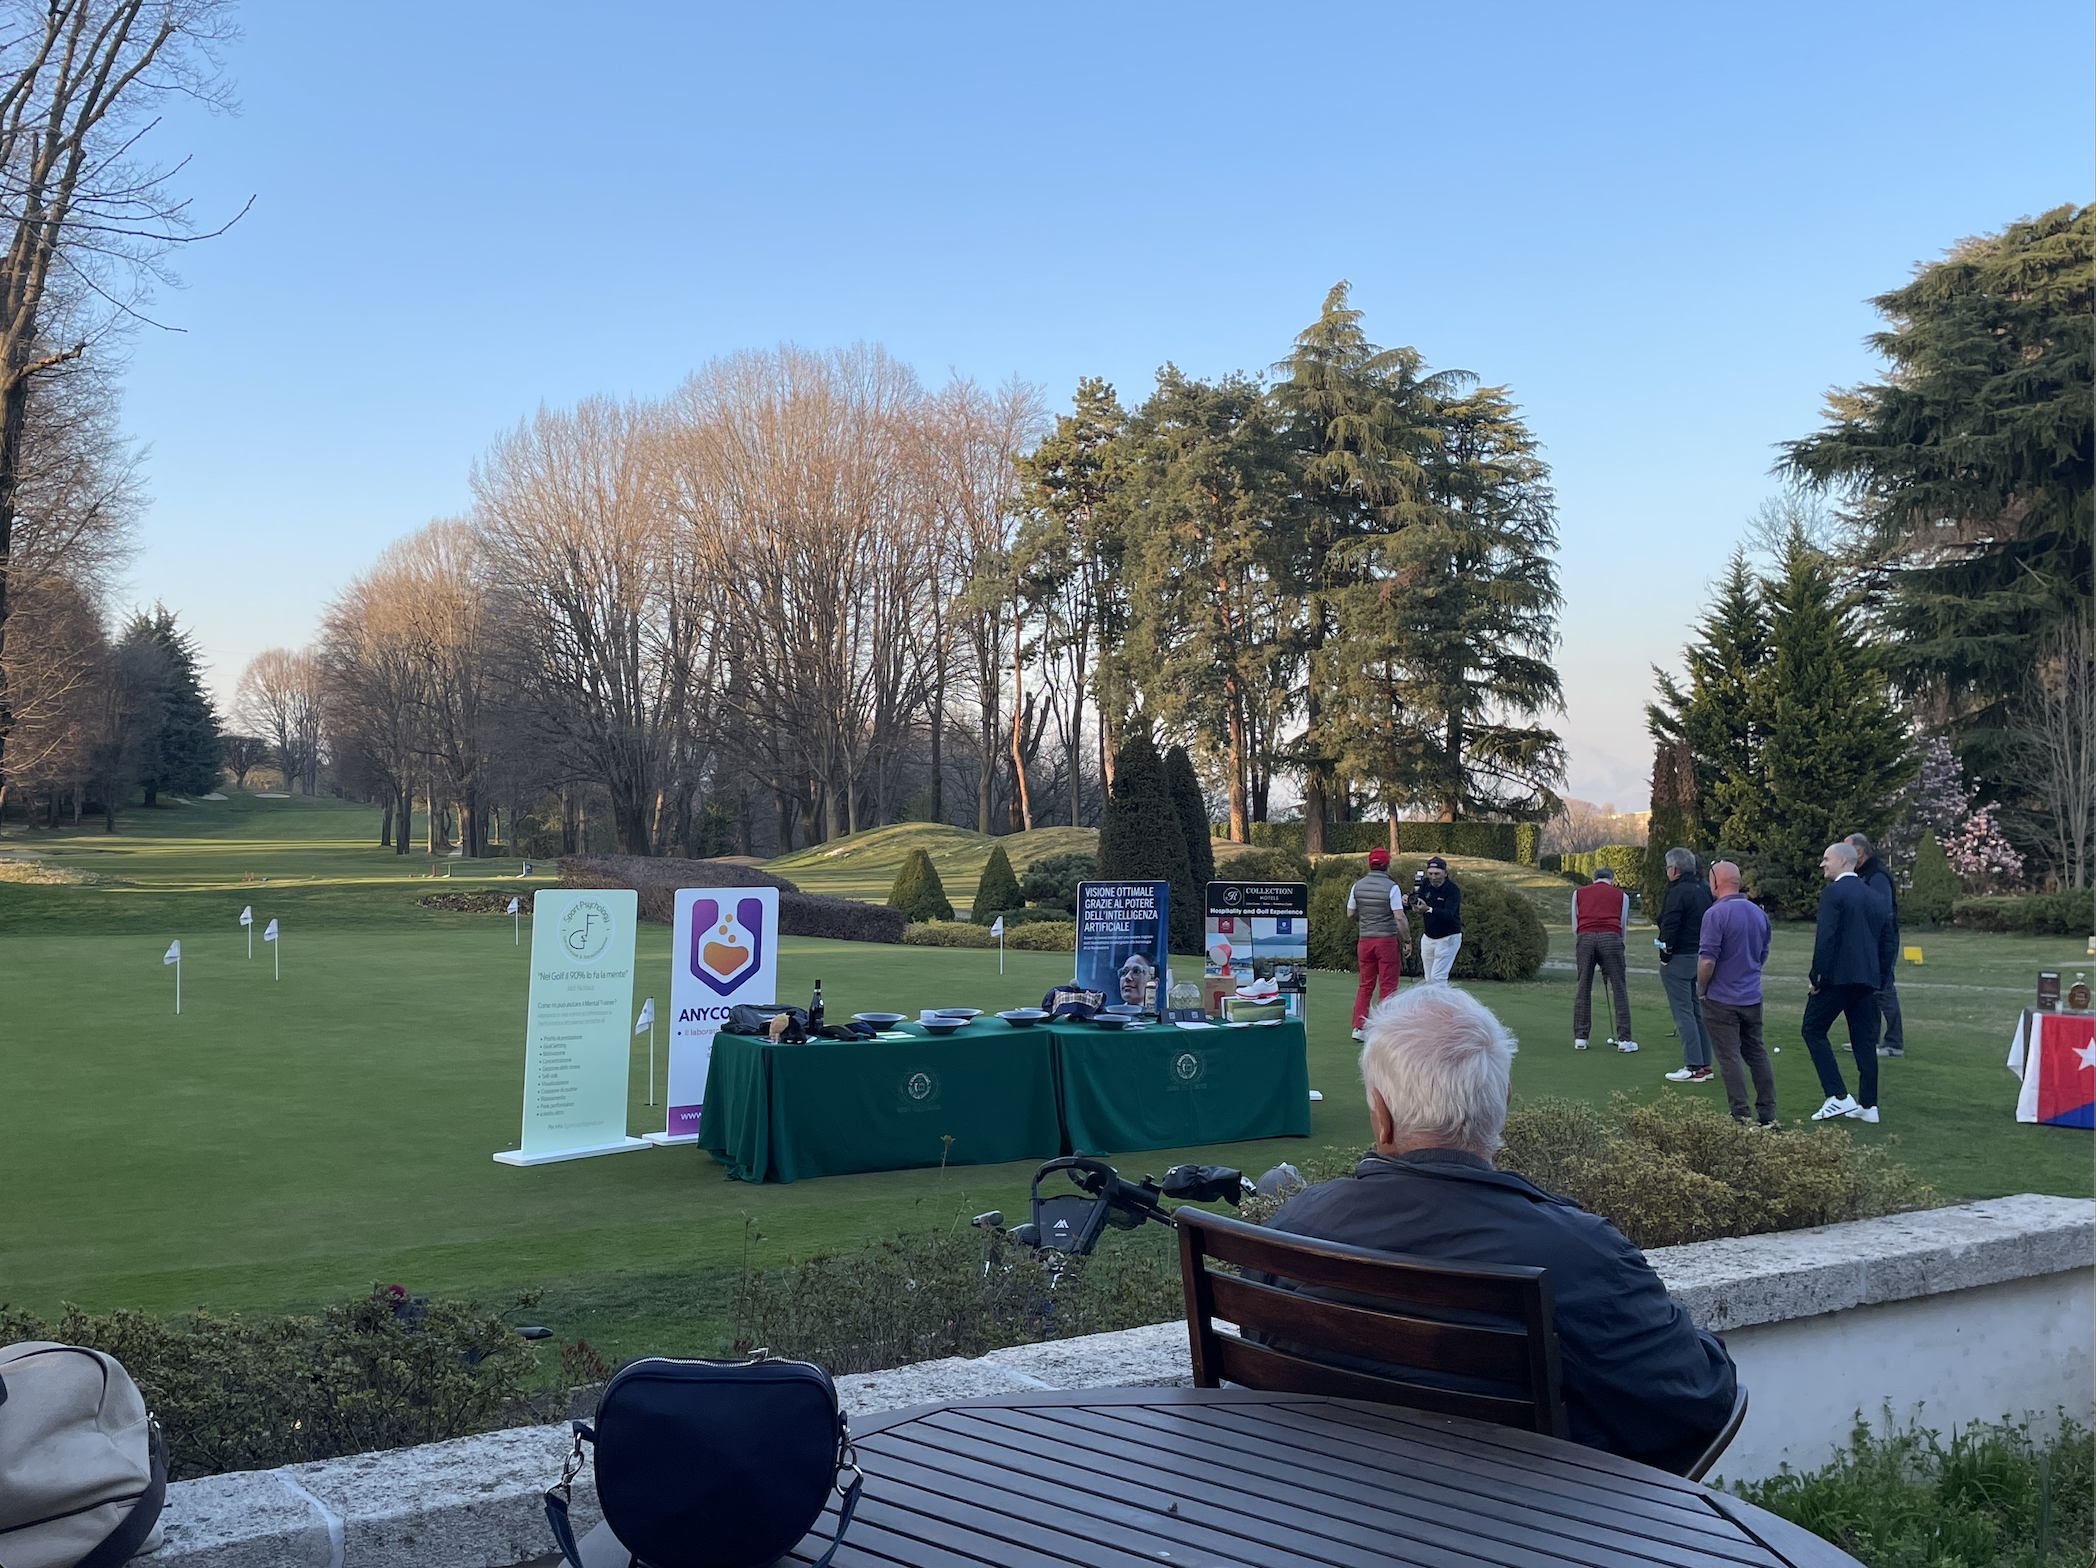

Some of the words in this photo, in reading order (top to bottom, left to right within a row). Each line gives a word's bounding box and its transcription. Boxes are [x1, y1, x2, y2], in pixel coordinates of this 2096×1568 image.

[1085, 887, 1115, 897] VISIONE
[1116, 886, 1154, 897] OTTIMALE
[1245, 887, 1294, 895] COLLECTION
[1085, 898, 1112, 909] GRAZIE
[1114, 898, 1124, 909] AL
[1125, 898, 1154, 908] POTERE
[563, 904, 580, 923] Sport
[579, 900, 611, 923] Psychology
[1084, 910, 1158, 920] DELL'INTELLIGENZA
[1210, 907, 1242, 915] Hospitality
[1084, 921, 1130, 932] ARTIFICIALE
[551, 971, 565, 980] Golf
[569, 970, 586, 980] 90%
[586, 970, 592, 979] lo
[593, 970, 600, 979] fa
[600, 970, 606, 979] la
[538, 1001, 551, 1009] Come
[585, 999, 600, 1007] Mental
[600, 998, 617, 1006] Trainer?
